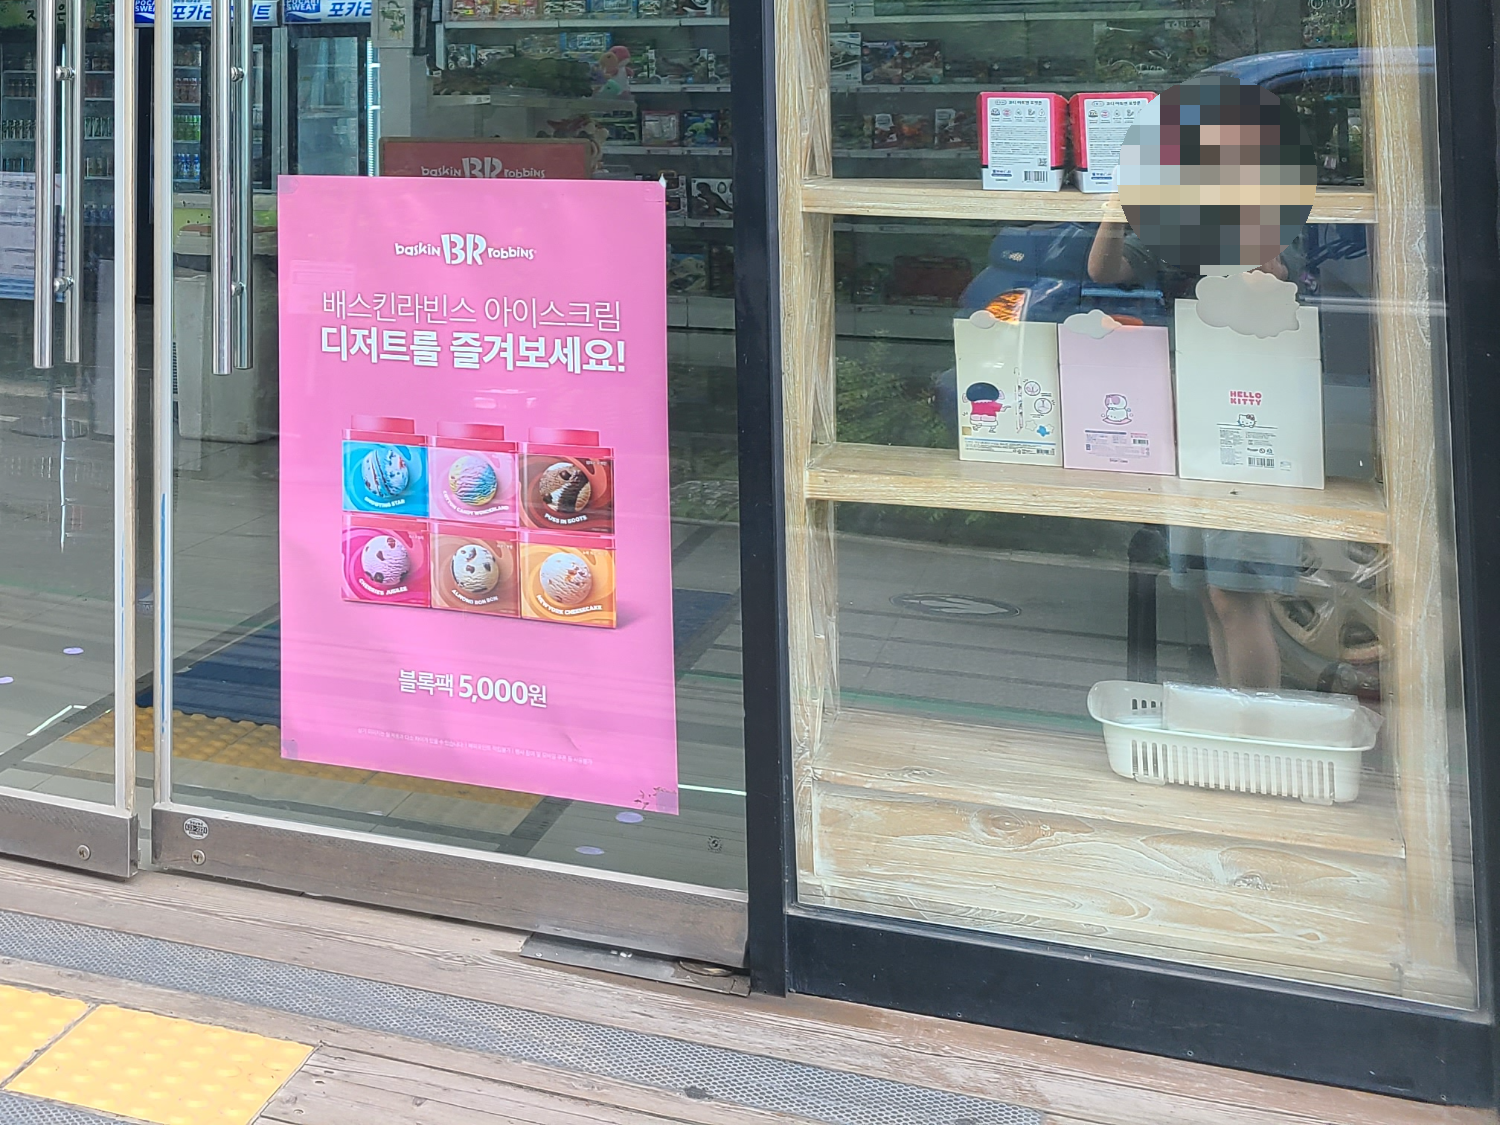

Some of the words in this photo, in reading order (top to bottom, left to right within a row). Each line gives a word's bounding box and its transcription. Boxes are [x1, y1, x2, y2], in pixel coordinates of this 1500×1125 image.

[421, 165, 462, 177] baskin
[504, 167, 545, 179] robbins
[394, 242, 441, 257] baskin
[441, 233, 487, 266] BR
[487, 246, 535, 260] robbins
[321, 289, 477, 324] 배스킨라빈스
[484, 295, 621, 332] 아이스크림
[321, 324, 442, 368] 디저트를
[449, 330, 626, 374] 즐겨보세요!
[1229, 390, 1262, 399] HELLO
[1230, 398, 1262, 406] KITTY
[398, 669, 454, 698] 블록팩
[458, 674, 548, 709] 5,000원
